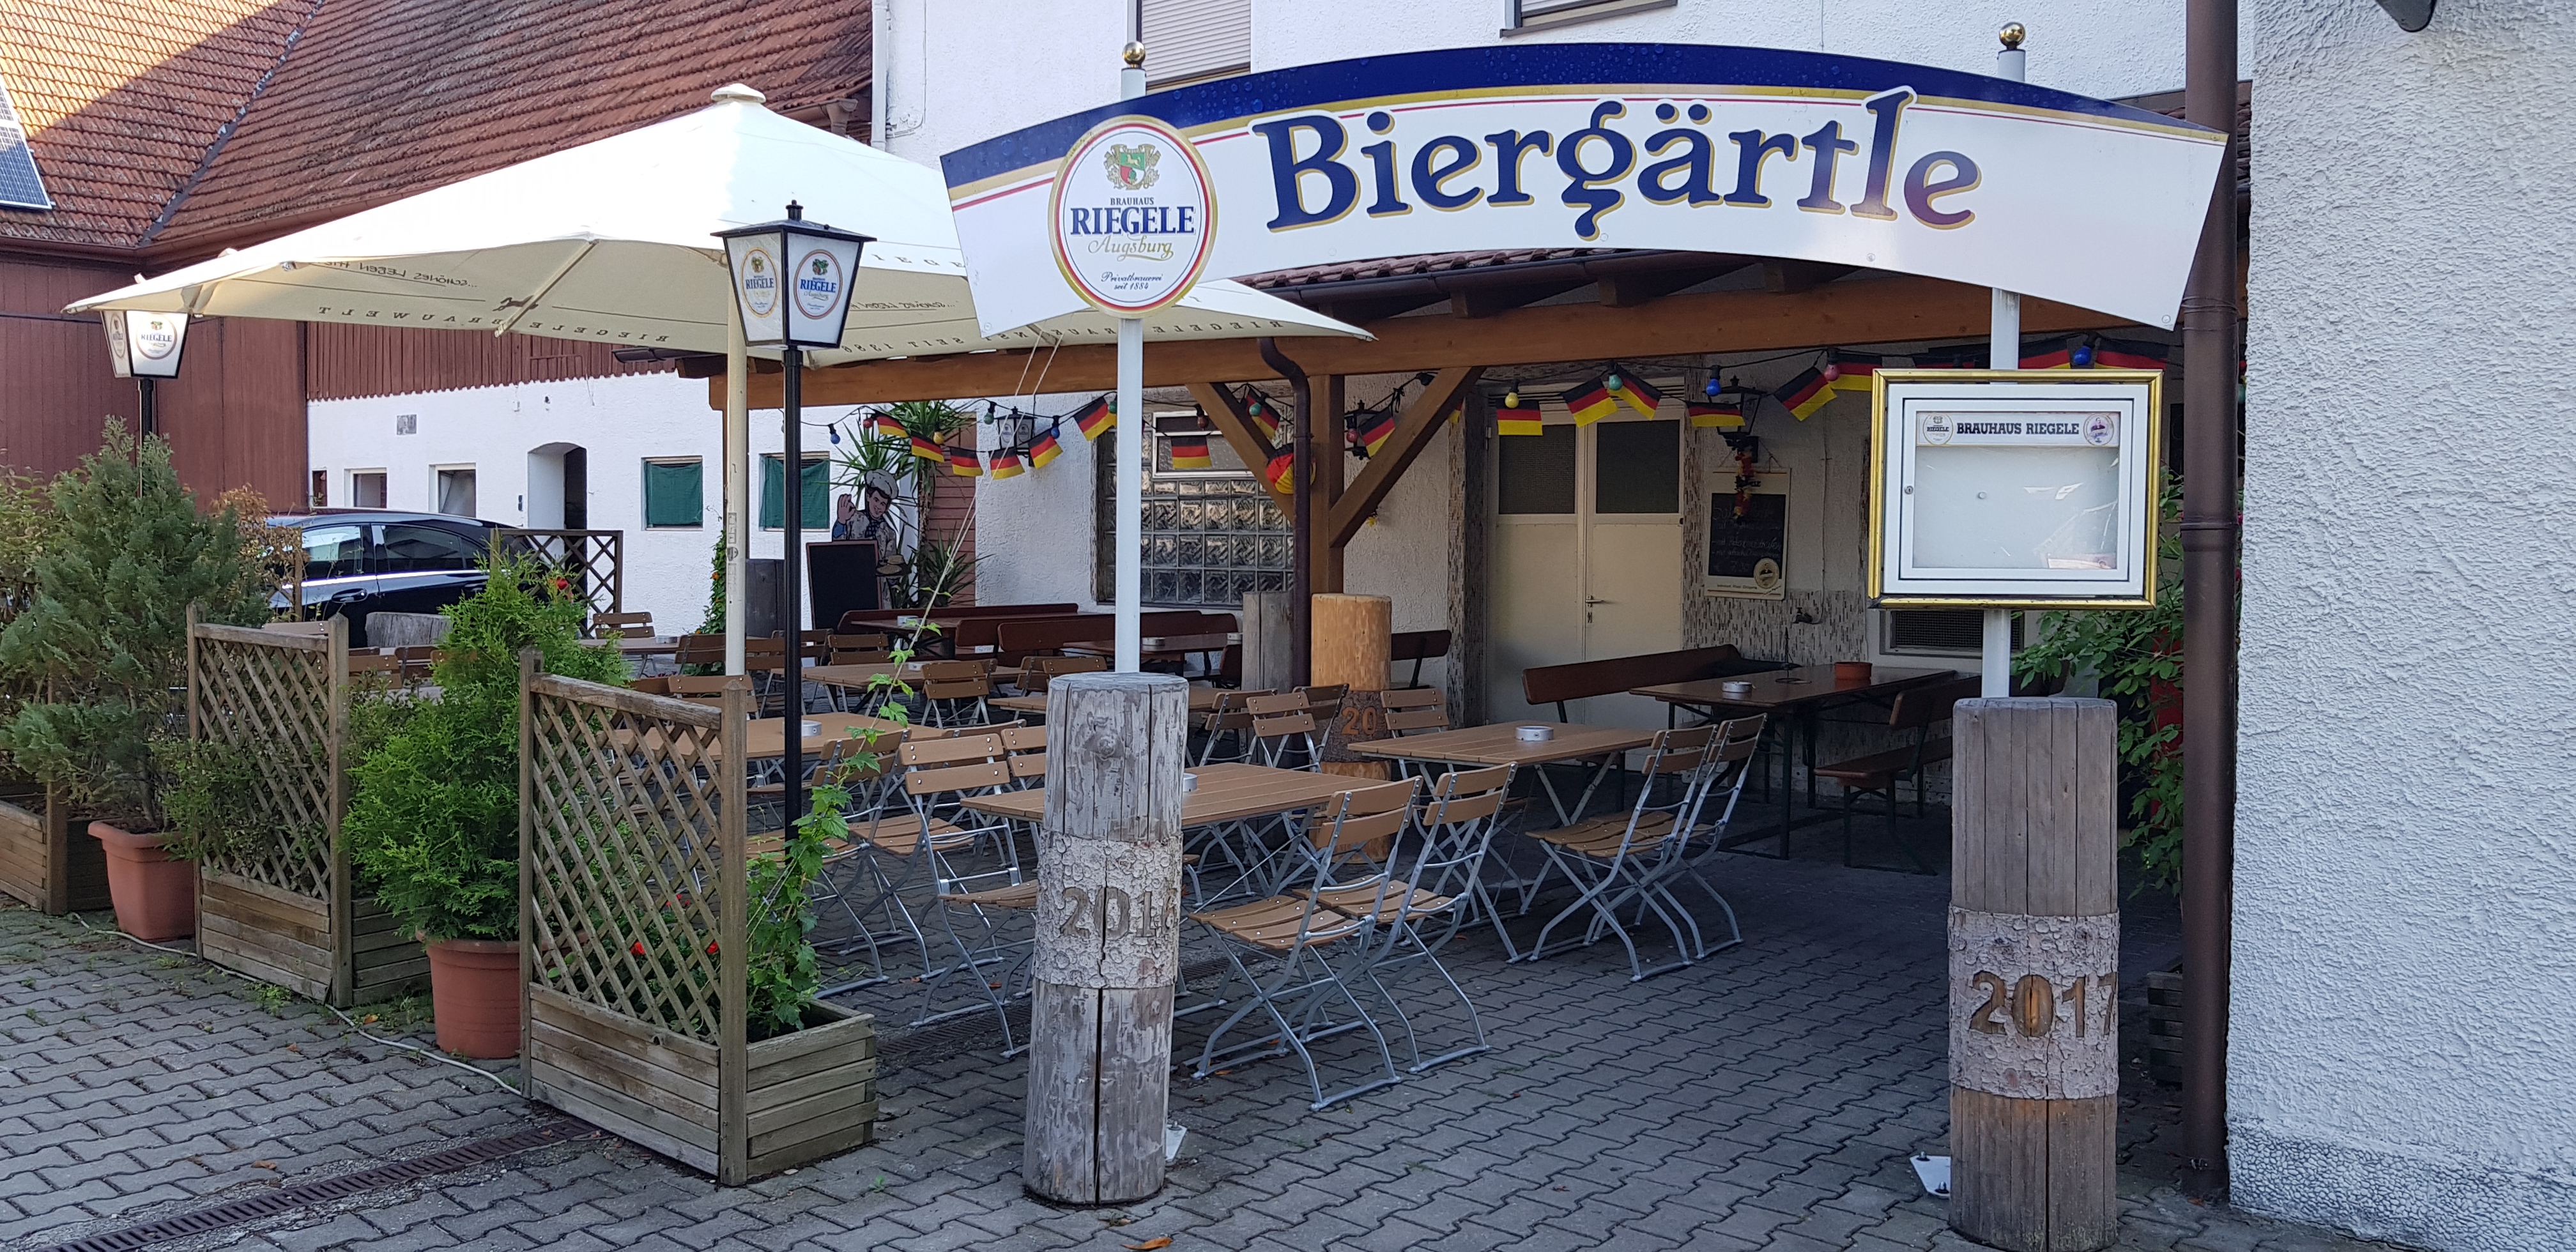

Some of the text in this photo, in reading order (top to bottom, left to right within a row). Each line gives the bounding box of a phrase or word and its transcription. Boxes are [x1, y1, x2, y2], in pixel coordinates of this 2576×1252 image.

[1252, 90, 1982, 240] Biergärtle
[1070, 206, 1194, 235] RIEGELE
[1087, 234, 1174, 261] Augsburg
[745, 277, 774, 289] RIEGELE
[800, 279, 837, 293] RIEGELE
[1101, 271, 1163, 282] Privatbrauerei
[1956, 423, 2022, 434] BRAUHAUS
[2025, 423, 2080, 435] RIEGELE
[1969, 970, 2117, 1039] 2017
